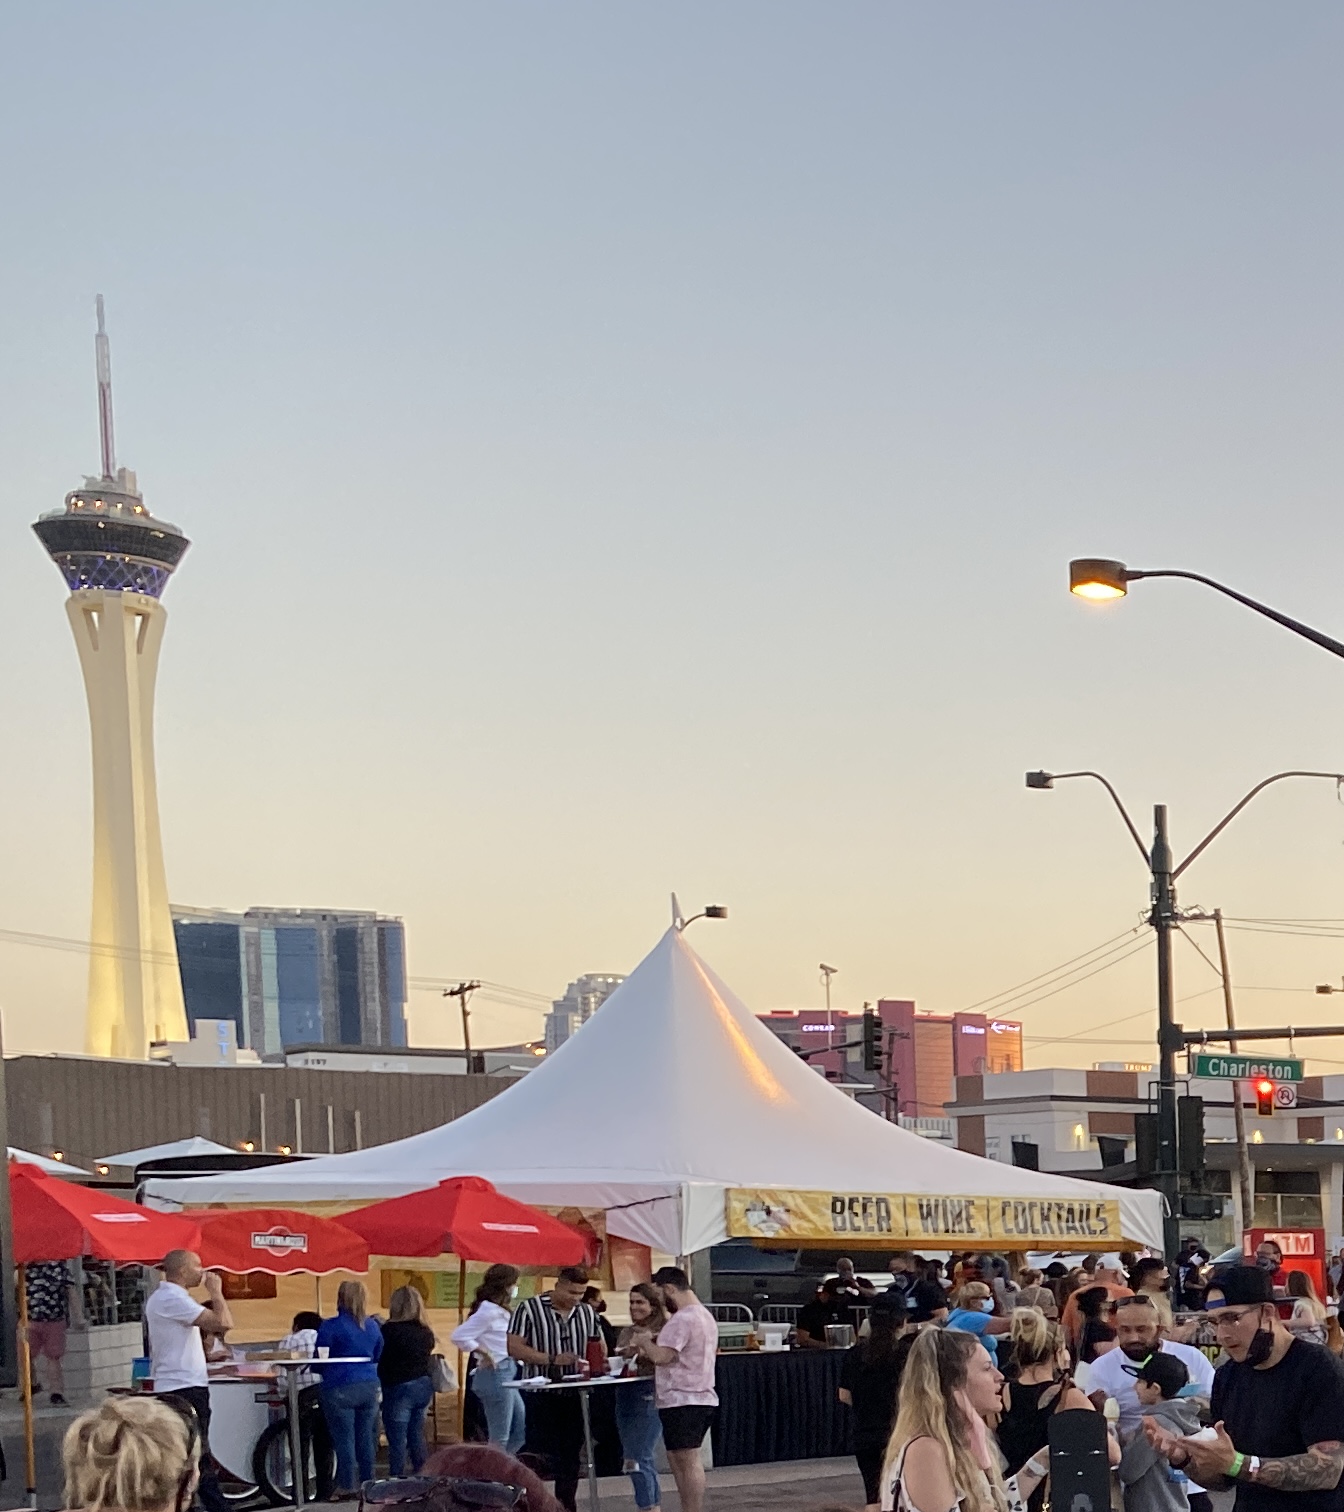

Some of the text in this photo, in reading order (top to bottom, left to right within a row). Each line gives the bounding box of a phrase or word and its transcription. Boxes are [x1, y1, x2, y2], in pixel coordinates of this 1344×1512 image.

[802, 1024, 836, 1032] CONRAD
[1208, 1058, 1292, 1079] Charleston
[831, 1195, 1110, 1236] BEER WINE COCKTAILS
